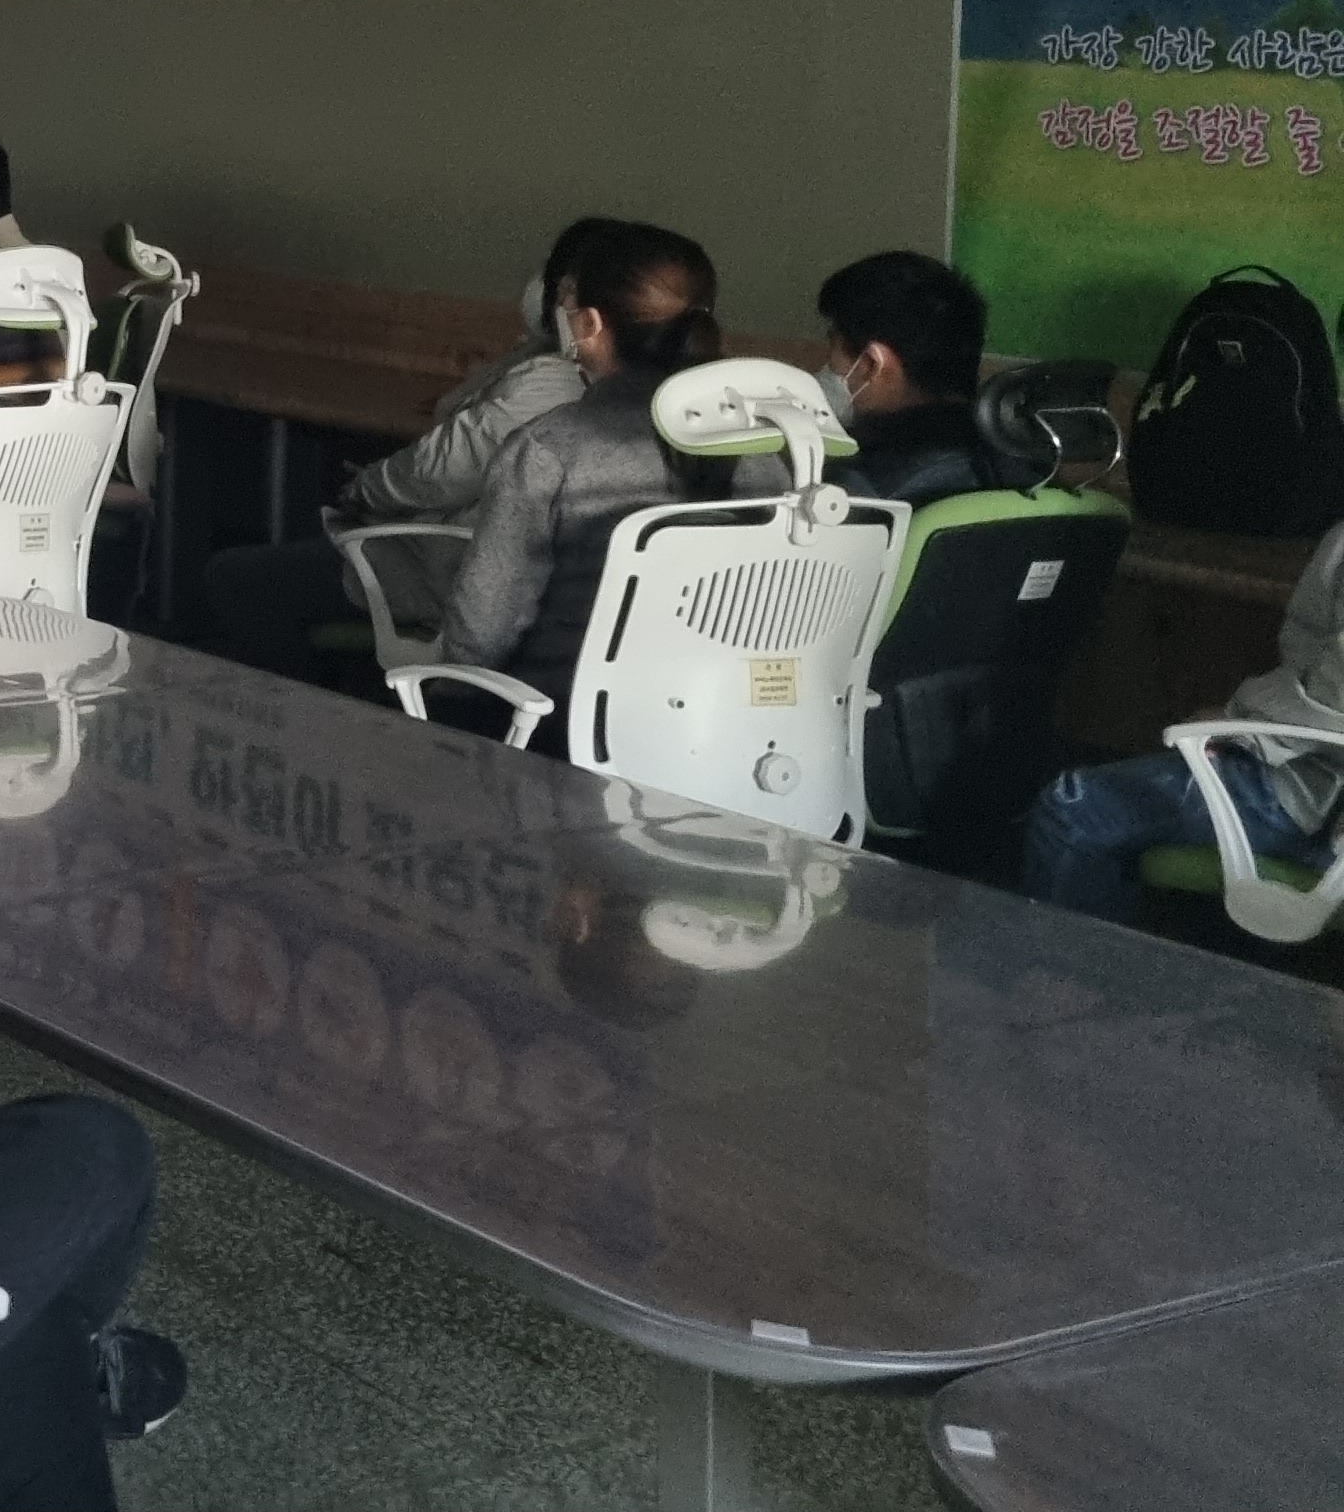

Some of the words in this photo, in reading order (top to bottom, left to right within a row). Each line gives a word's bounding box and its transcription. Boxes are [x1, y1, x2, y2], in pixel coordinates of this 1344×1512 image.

[1041, 25, 1123, 70] 가장
[1135, 26, 1215, 73] 강한
[1039, 98, 1143, 161] 감정을
[1153, 102, 1270, 166] 조절할
[1286, 105, 1323, 175] 줄
